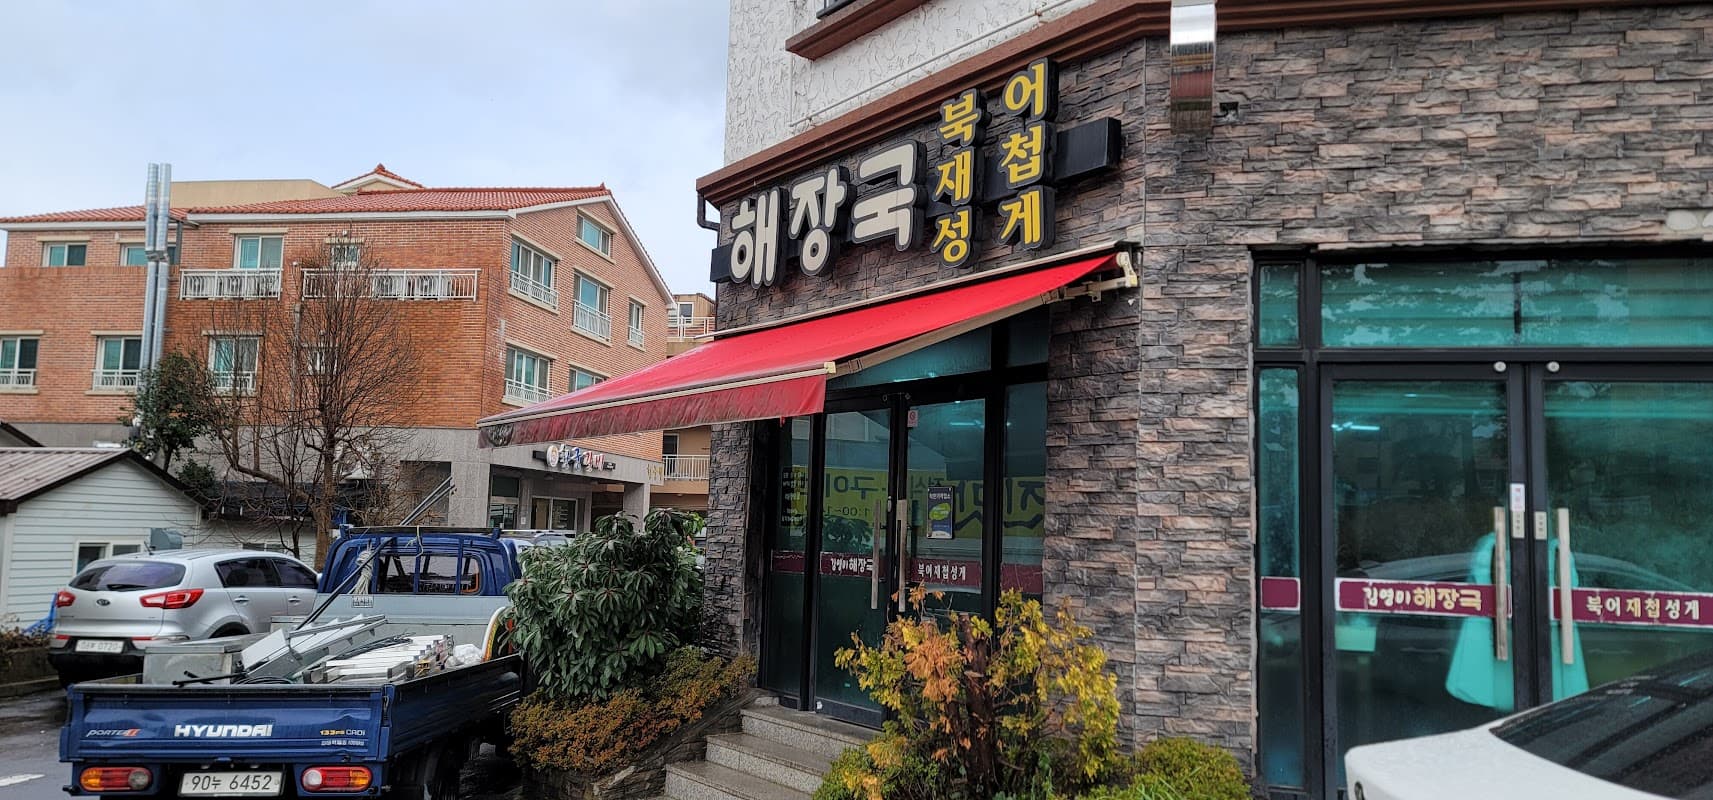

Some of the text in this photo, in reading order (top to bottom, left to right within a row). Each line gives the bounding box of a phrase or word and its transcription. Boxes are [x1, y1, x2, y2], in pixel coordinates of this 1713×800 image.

[731, 143, 915, 286] 해장국
[831, 558, 849, 572] 김영미
[1362, 586, 1482, 611] 김영미 해장국
[174, 723, 273, 737] HYUNDAI
[191, 775, 272, 791] 90누 6452
